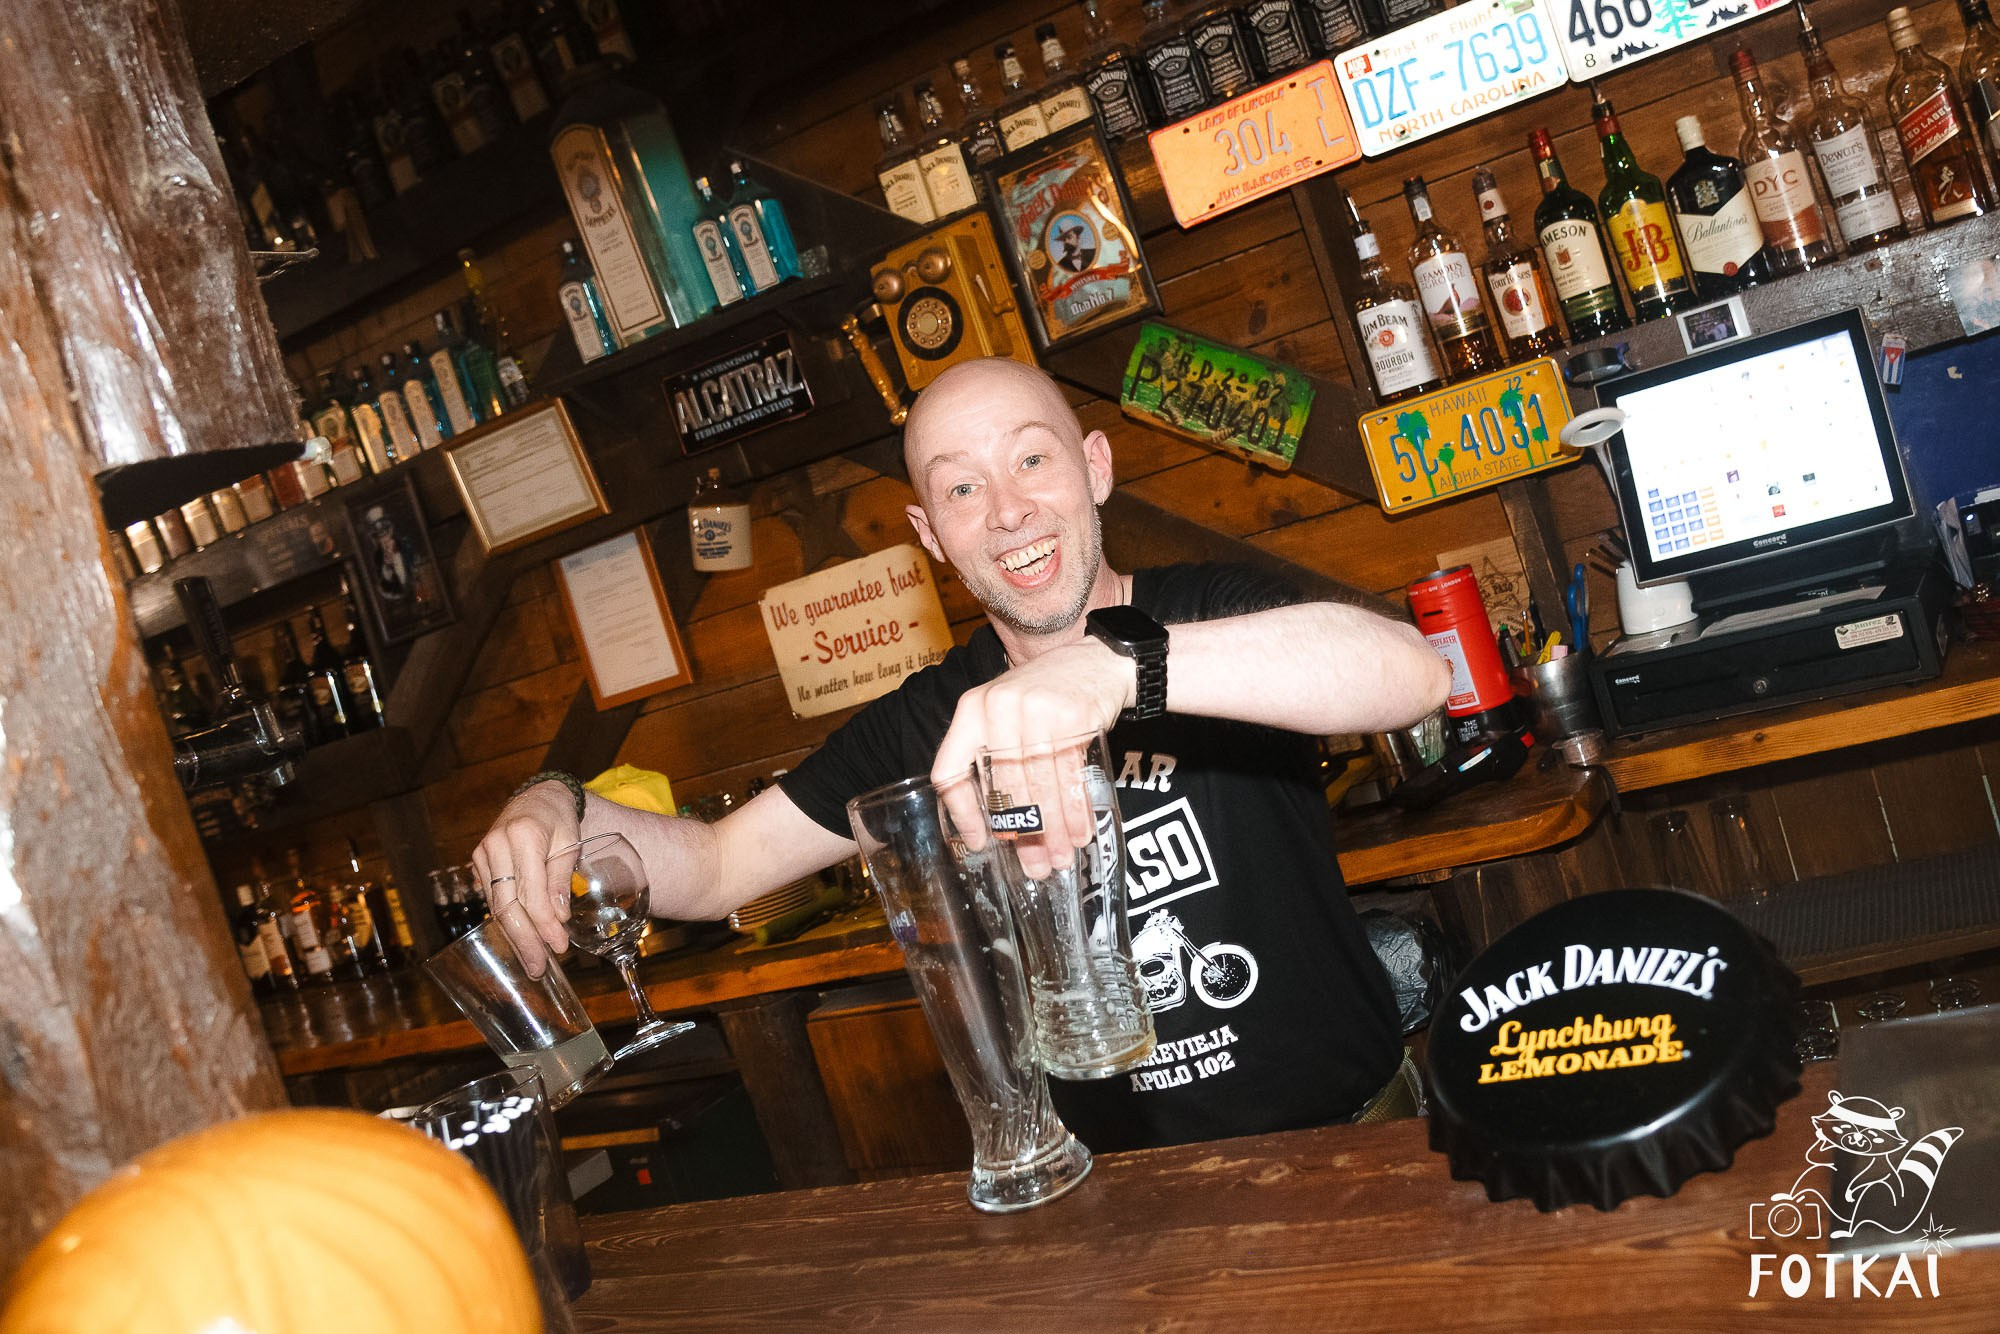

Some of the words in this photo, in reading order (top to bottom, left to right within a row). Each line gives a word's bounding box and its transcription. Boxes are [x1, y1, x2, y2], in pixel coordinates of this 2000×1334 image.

[1148, 53, 1164, 71] JACK
[1162, 46, 1190, 58] DANIEL'S
[1352, 12, 1548, 129] DZF-7639
[1584, 53, 1597, 68] 8
[1198, 113, 1225, 132] LAND
[1227, 105, 1240, 120] OF
[1241, 87, 1284, 113] LINCOLN
[1379, 108, 1444, 144] NORTH
[1451, 71, 1546, 117] CAROLINA
[1215, 110, 1293, 176] 304
[1820, 143, 1864, 166] Dewar's
[1242, 164, 1292, 192] ILLINOIS
[1753, 169, 1798, 197] DYC
[1623, 223, 1670, 272] J&B
[1686, 213, 1748, 245] Ballantine's
[1362, 321, 1379, 341] JIM
[1377, 313, 1409, 328] BEAM
[1374, 351, 1415, 373] BOURBON
[675, 349, 804, 435] ALCATRAZ
[1429, 386, 1488, 418] HAWAII
[1504, 375, 1523, 392] 72
[694, 419, 732, 440] FEDERAL
[732, 397, 794, 426] PENITENTIARY
[1439, 466, 1482, 490] ALOHA
[1484, 455, 1522, 476] STATE
[1753, 533, 1787, 547] Concord
[769, 602, 800, 631] We
[804, 579, 885, 627] guarantee
[887, 561, 925, 597] fast
[814, 618, 904, 666] Service
[797, 686, 811, 703] No
[814, 677, 849, 698] matter
[852, 669, 874, 687] how
[877, 662, 901, 680] long
[905, 655, 914, 670] it
[1116, 751, 1177, 793] AR
[1460, 960, 1560, 1033] JACK
[1562, 944, 1728, 997] DANIEL'S
[1489, 1013, 1677, 1063] Lynchburg
[1129, 1064, 1193, 1092] APOLO
[1194, 1051, 1236, 1079] 102
[1477, 1039, 1684, 1084] LEMONADE
